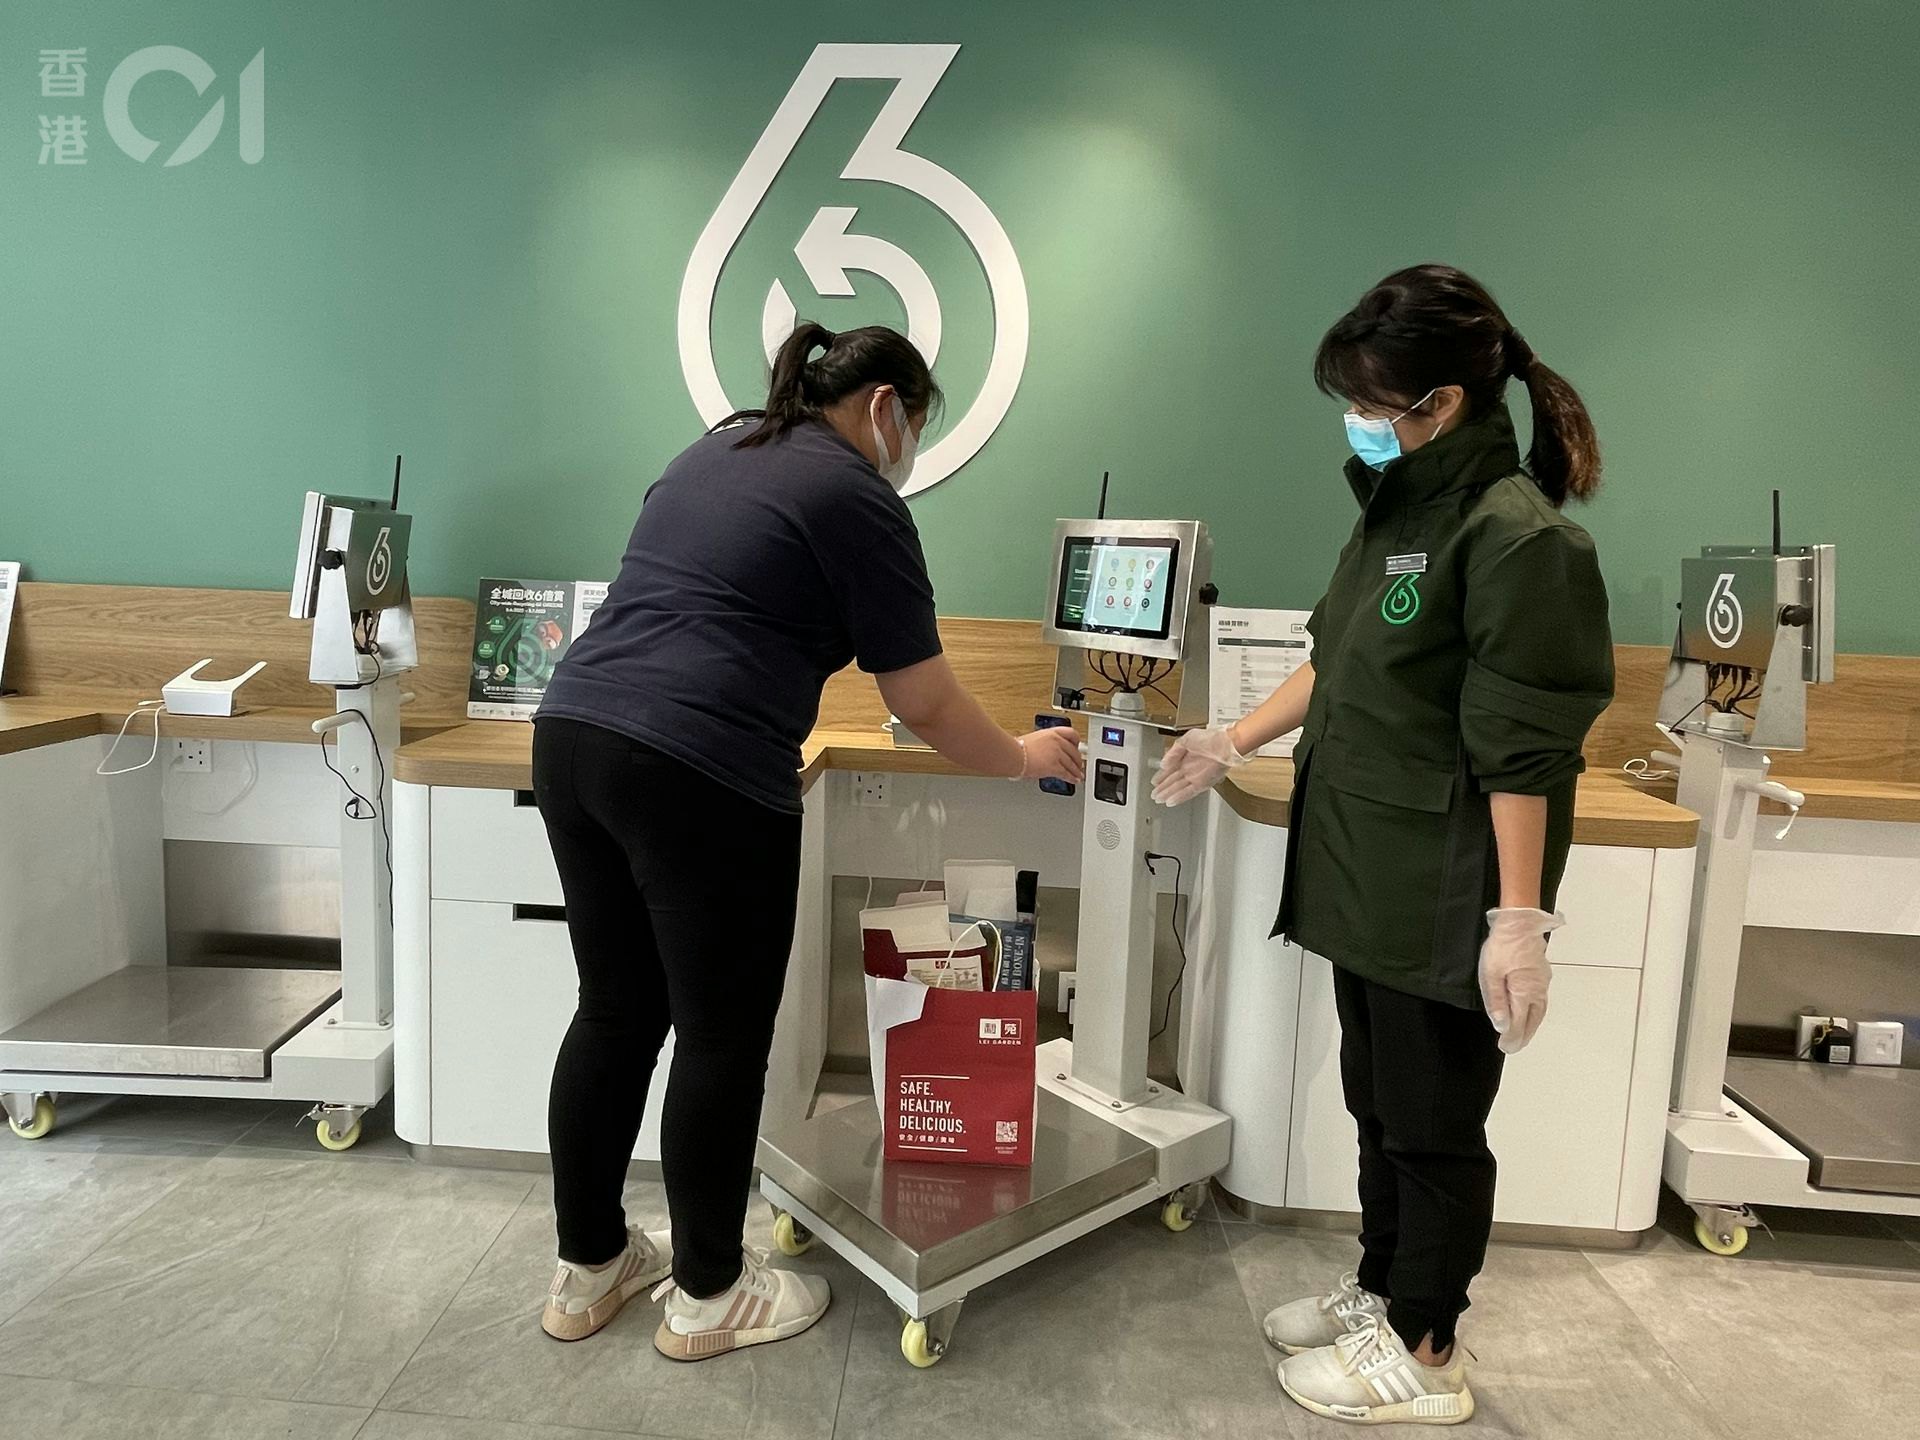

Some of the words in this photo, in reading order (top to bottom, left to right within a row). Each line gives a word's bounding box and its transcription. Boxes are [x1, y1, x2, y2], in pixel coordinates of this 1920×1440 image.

[490, 587, 565, 602] 全城回收6倍賞
[1012, 935, 1025, 977] BONE-IN
[900, 1081, 934, 1096] SAFE.
[900, 1098, 954, 1115] HEALTHY.
[899, 1115, 967, 1134] DELICIOUS.
